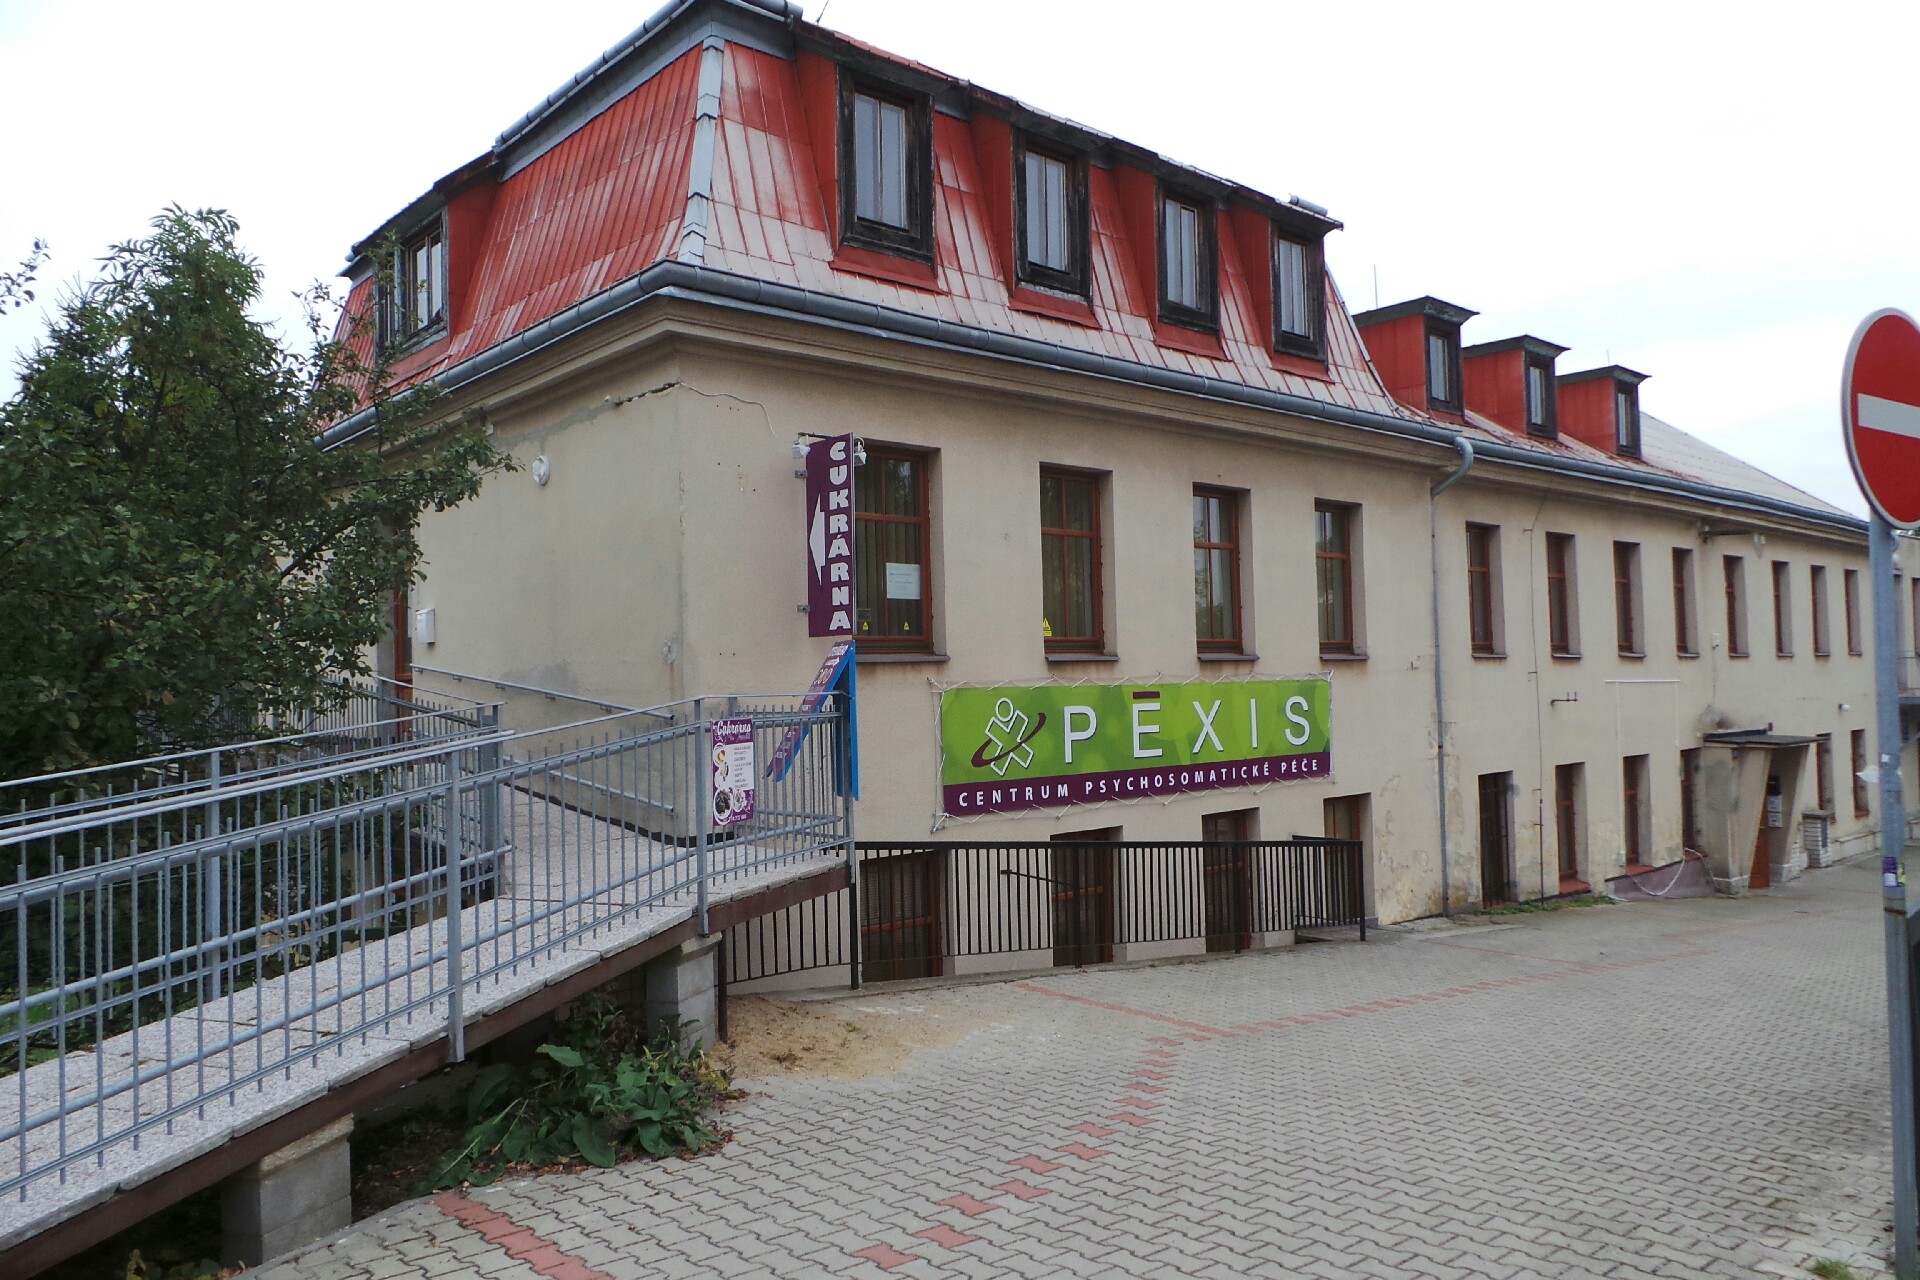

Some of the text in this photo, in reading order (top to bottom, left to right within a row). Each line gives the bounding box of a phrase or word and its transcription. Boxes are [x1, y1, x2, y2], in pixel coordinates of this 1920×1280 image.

[828, 441, 851, 631] CUKRÁRNA
[958, 758, 1319, 808] CENTRUM PSYCHOSOMATICKÉ PÉČE
